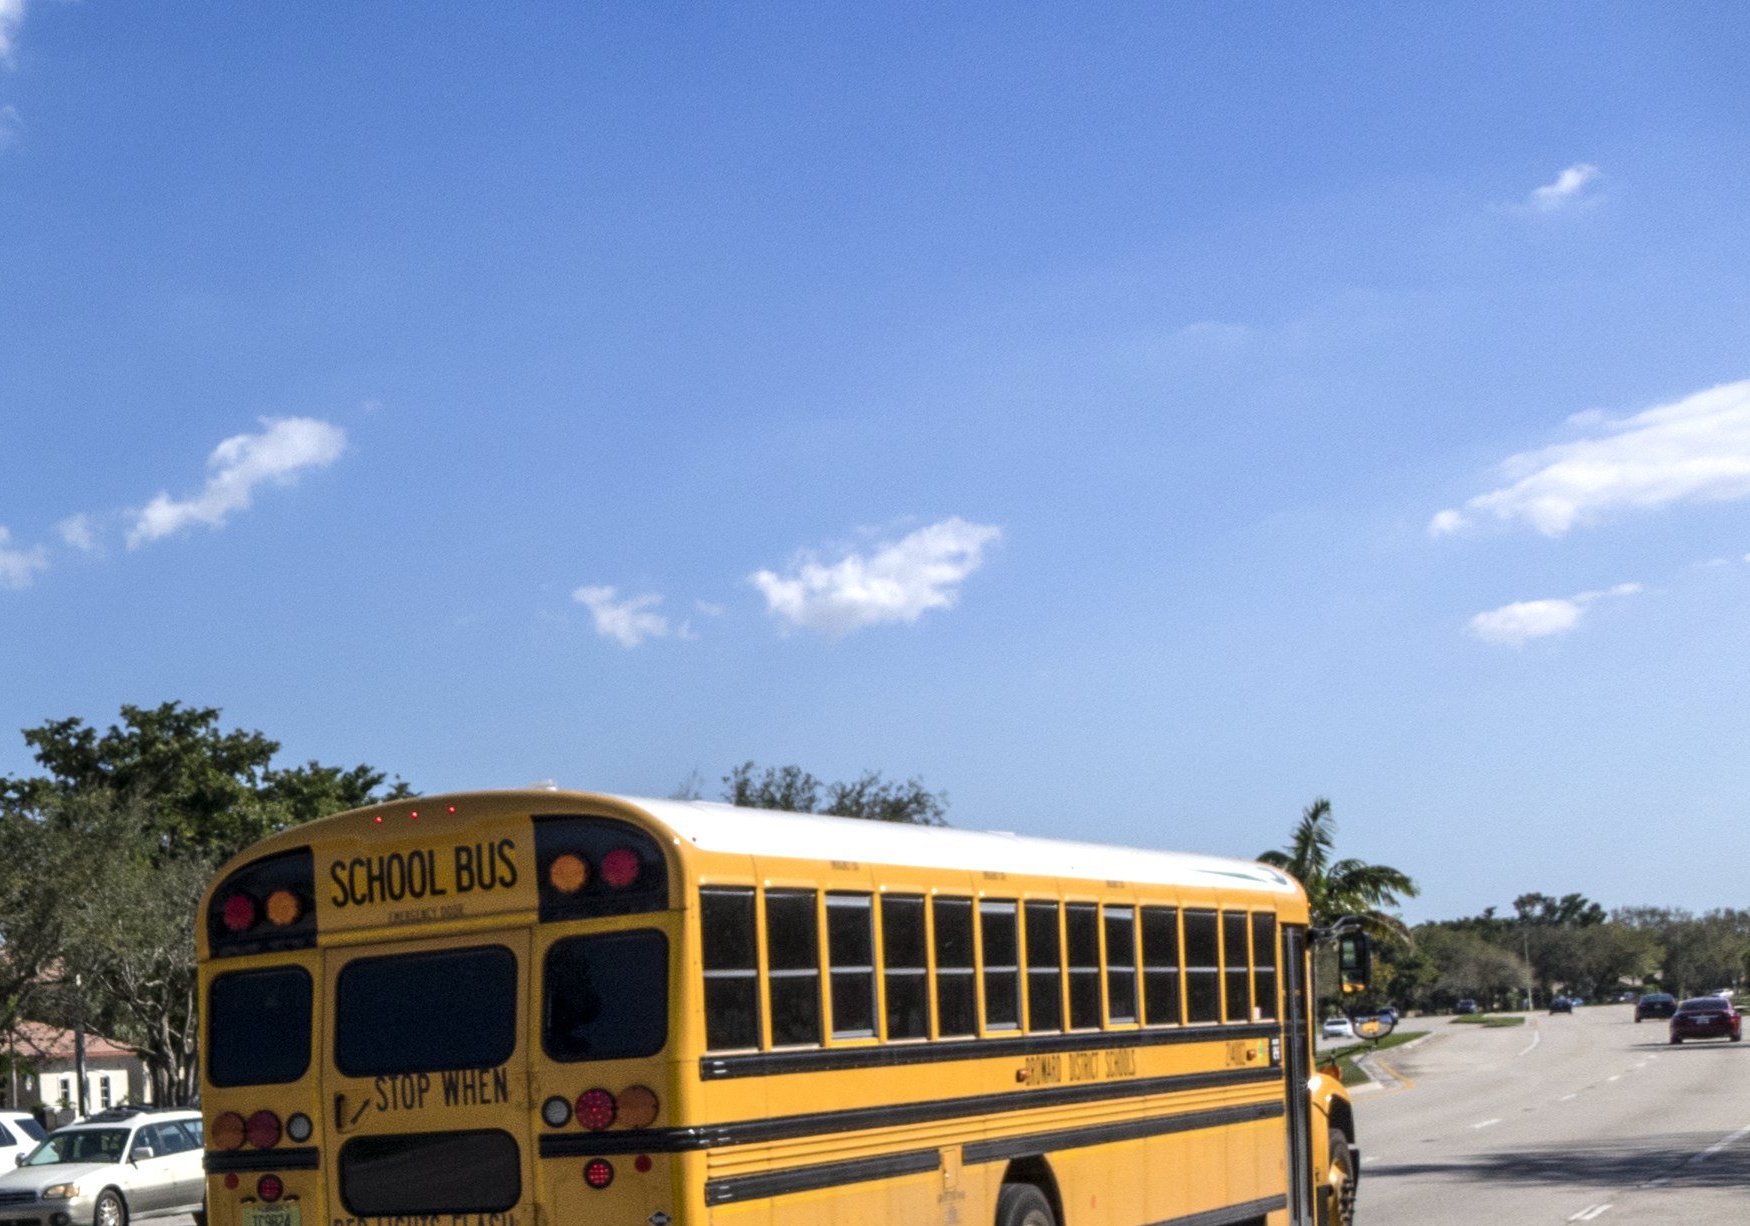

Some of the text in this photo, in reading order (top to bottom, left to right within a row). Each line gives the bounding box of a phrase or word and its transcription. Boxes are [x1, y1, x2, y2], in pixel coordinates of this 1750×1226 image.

[330, 838, 518, 908] SCHOOL BUS
[374, 1068, 509, 1112] STOP WHEN
